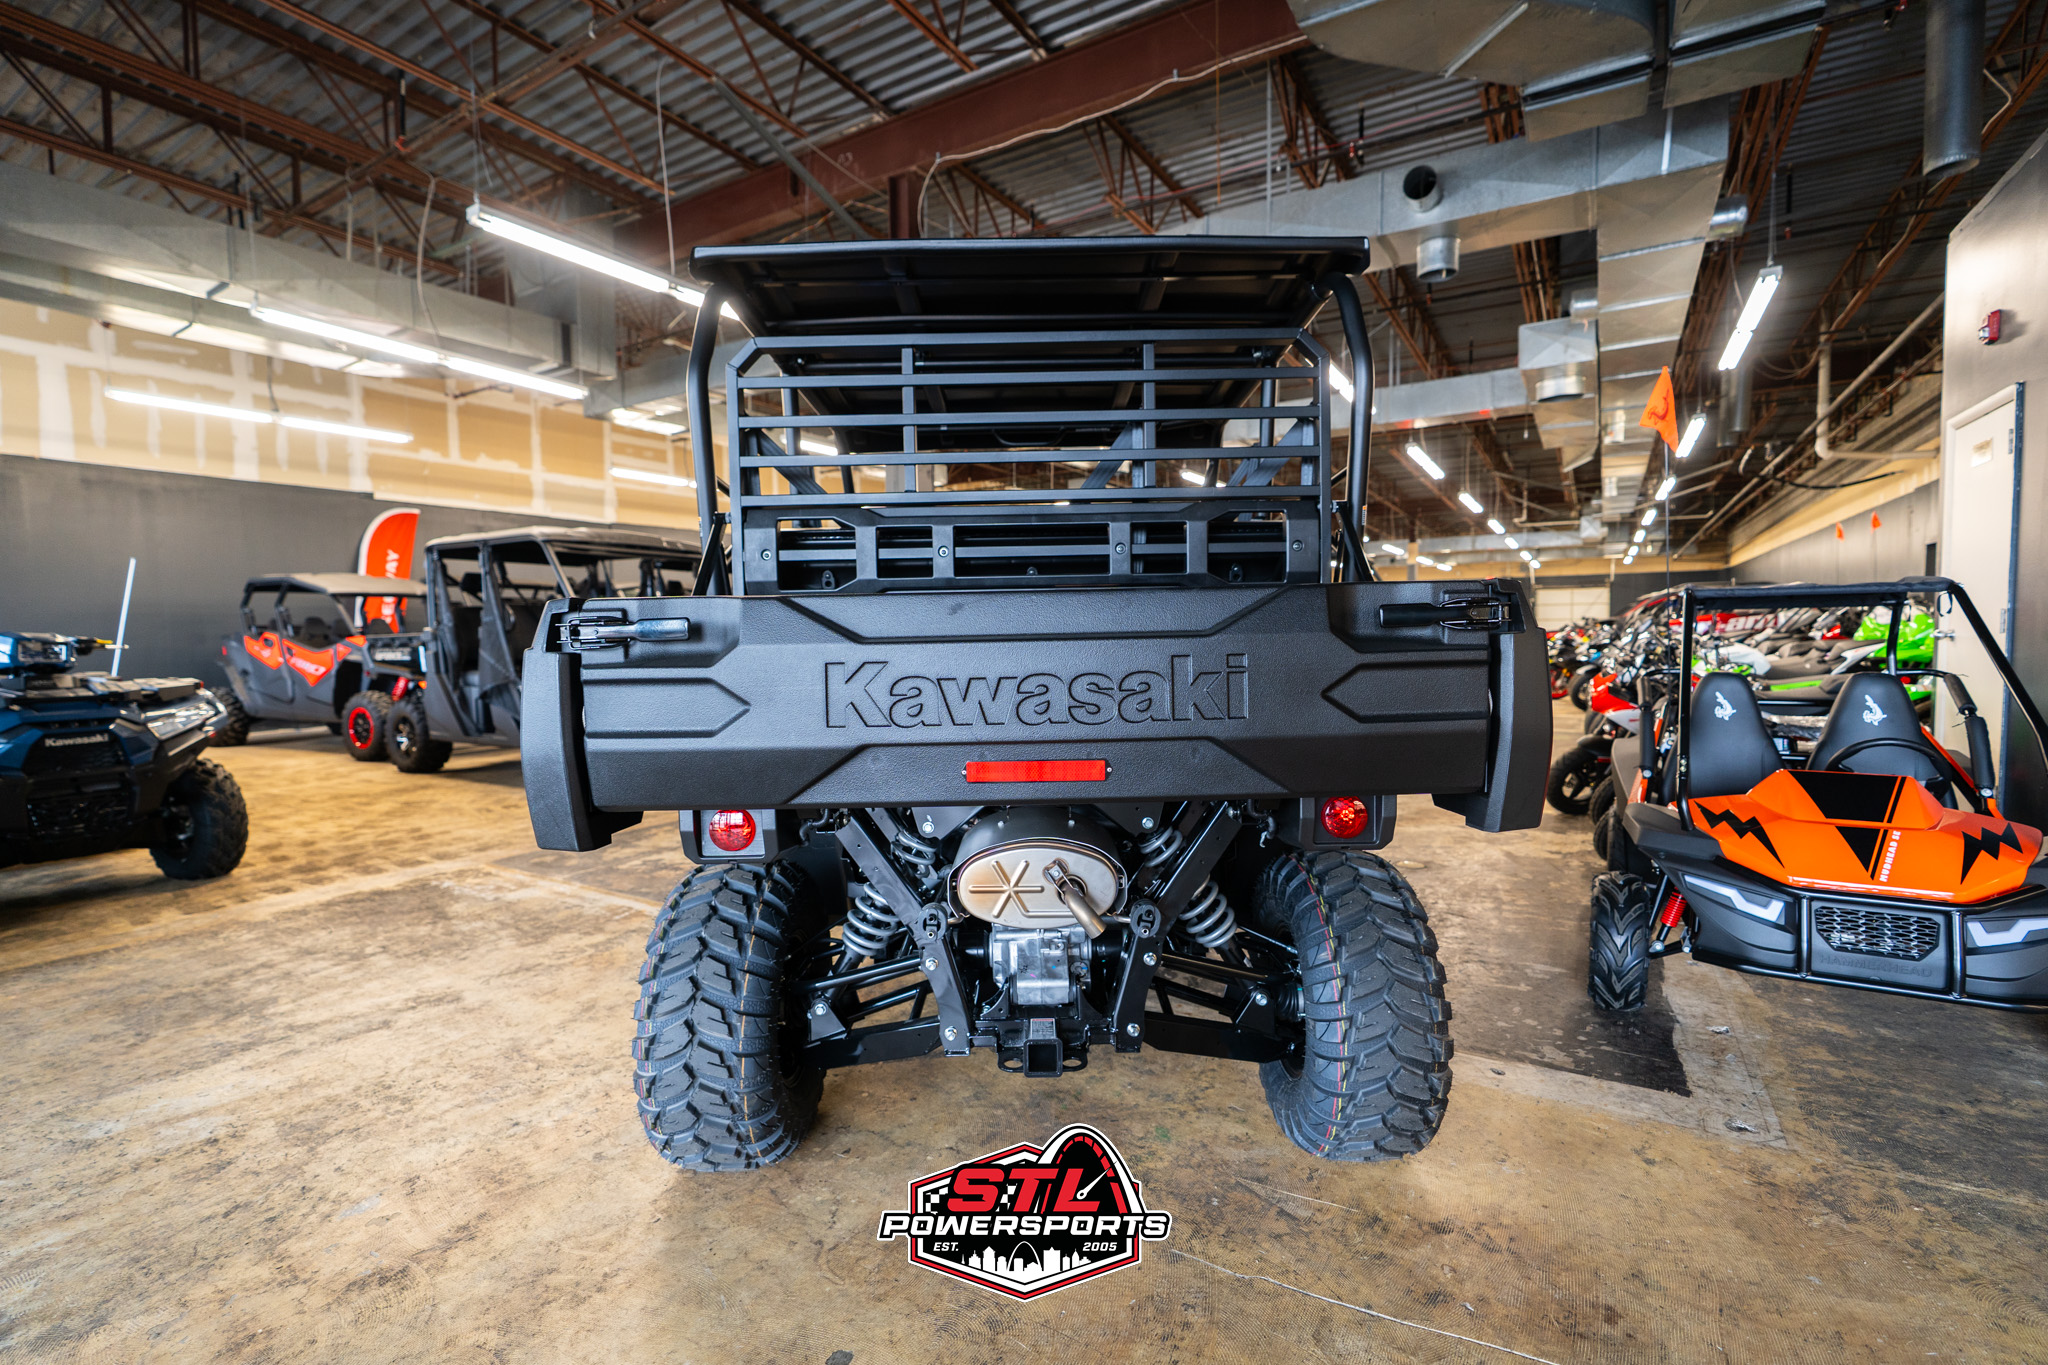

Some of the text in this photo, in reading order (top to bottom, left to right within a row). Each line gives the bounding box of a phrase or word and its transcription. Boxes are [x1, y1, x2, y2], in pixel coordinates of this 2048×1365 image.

[825, 654, 1249, 729] Kawasaki
[44, 733, 109, 747] Kawasaki
[1879, 830, 1902, 883] MUDHEAD SE
[1819, 954, 1933, 978] HAMMERHEAD
